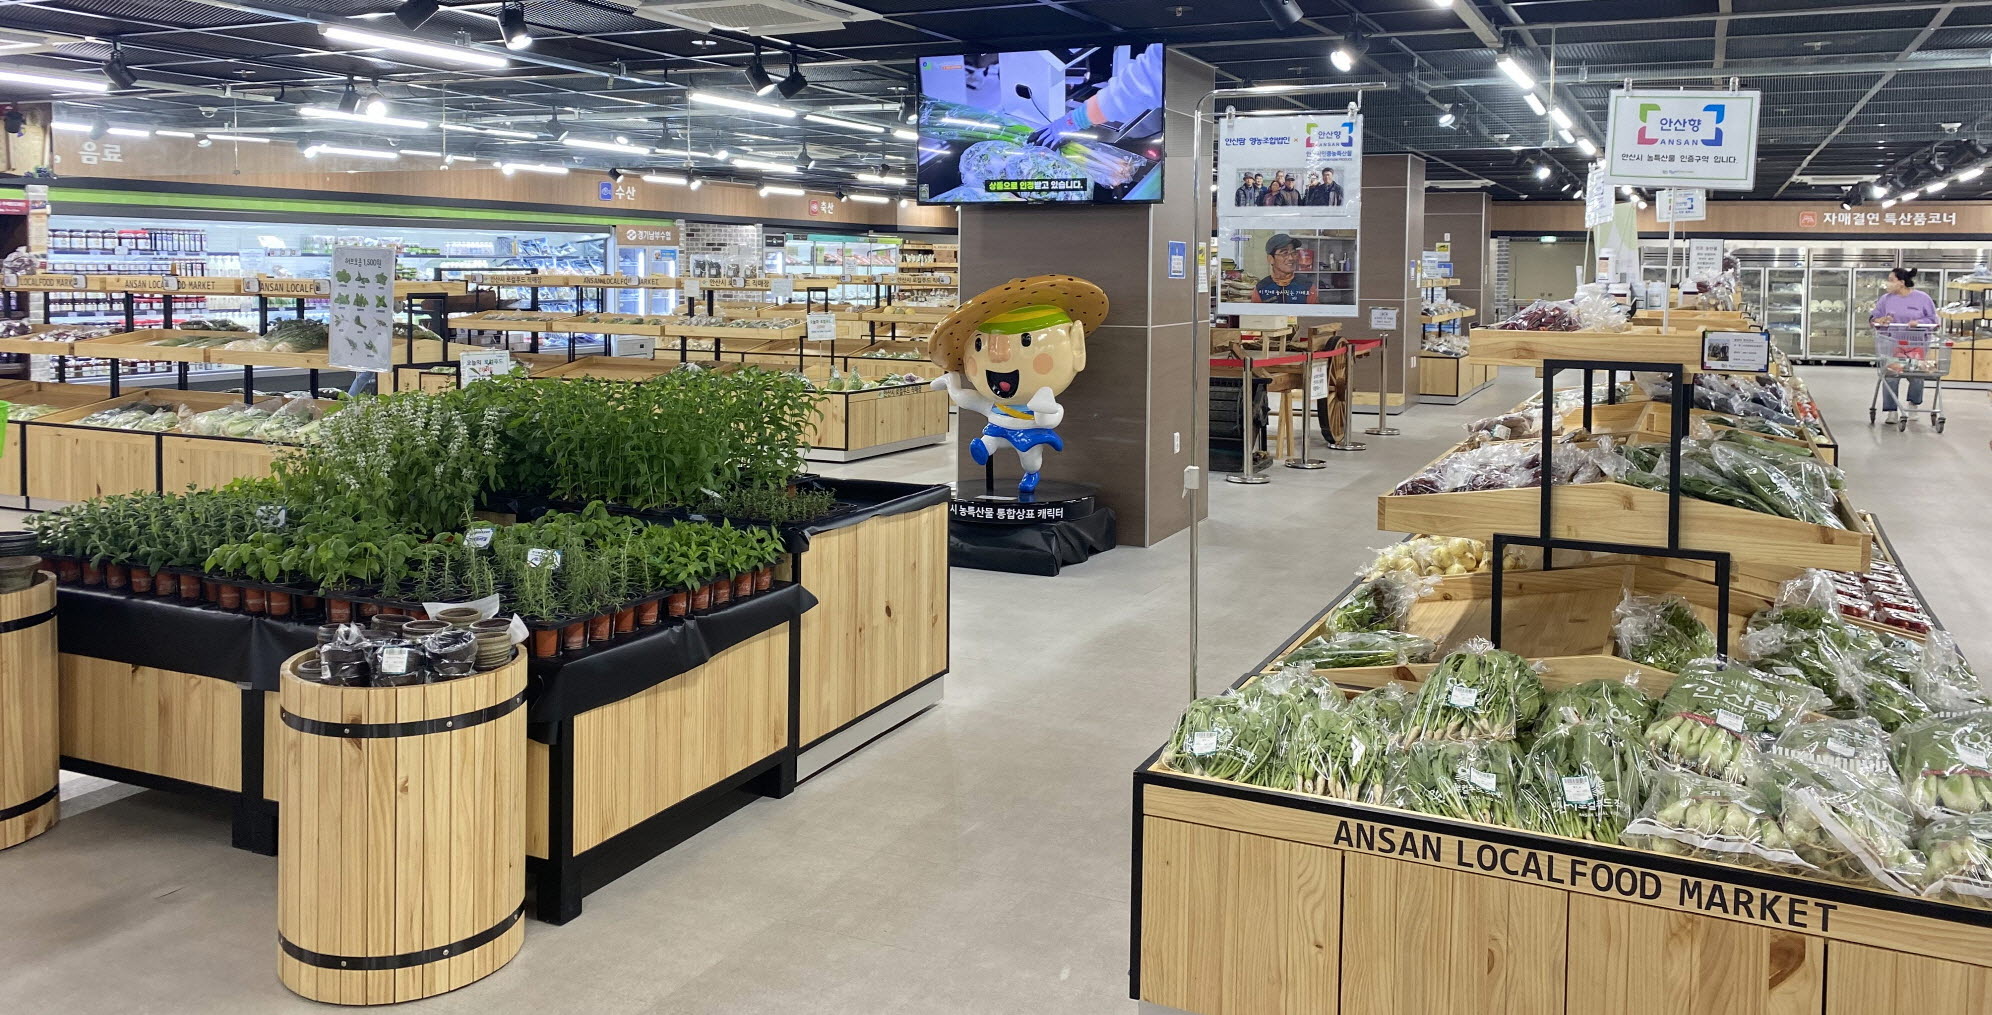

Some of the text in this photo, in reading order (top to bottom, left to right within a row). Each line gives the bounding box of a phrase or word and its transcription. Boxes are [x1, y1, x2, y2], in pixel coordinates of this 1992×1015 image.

[1660, 118, 1702, 132] 안산향
[1317, 130, 1342, 139] 안산향
[79, 141, 123, 165] 음료
[1621, 153, 1738, 164] 안산시 농특산물 인증구역 입니다.
[989, 180, 1083, 190] 상품으로 인정받고 있습니다.
[615, 186, 636, 200] 수산
[820, 201, 834, 215] 축산
[1823, 212, 1957, 226] 자매결연 특산품코너
[636, 230, 671, 241] 경기남부수협
[124, 280, 147, 289] ANSAN
[189, 281, 215, 290] MARKET
[260, 282, 284, 292] ANSAN
[709, 279, 727, 287] 안산시
[752, 279, 769, 288] 직매장
[959, 505, 994, 519] 농특산물
[996, 508, 1035, 520] 통합상표
[1037, 507, 1064, 519] 캐릭터
[1333, 820, 1838, 932] ANSAN LOCALFOOD MARKET
